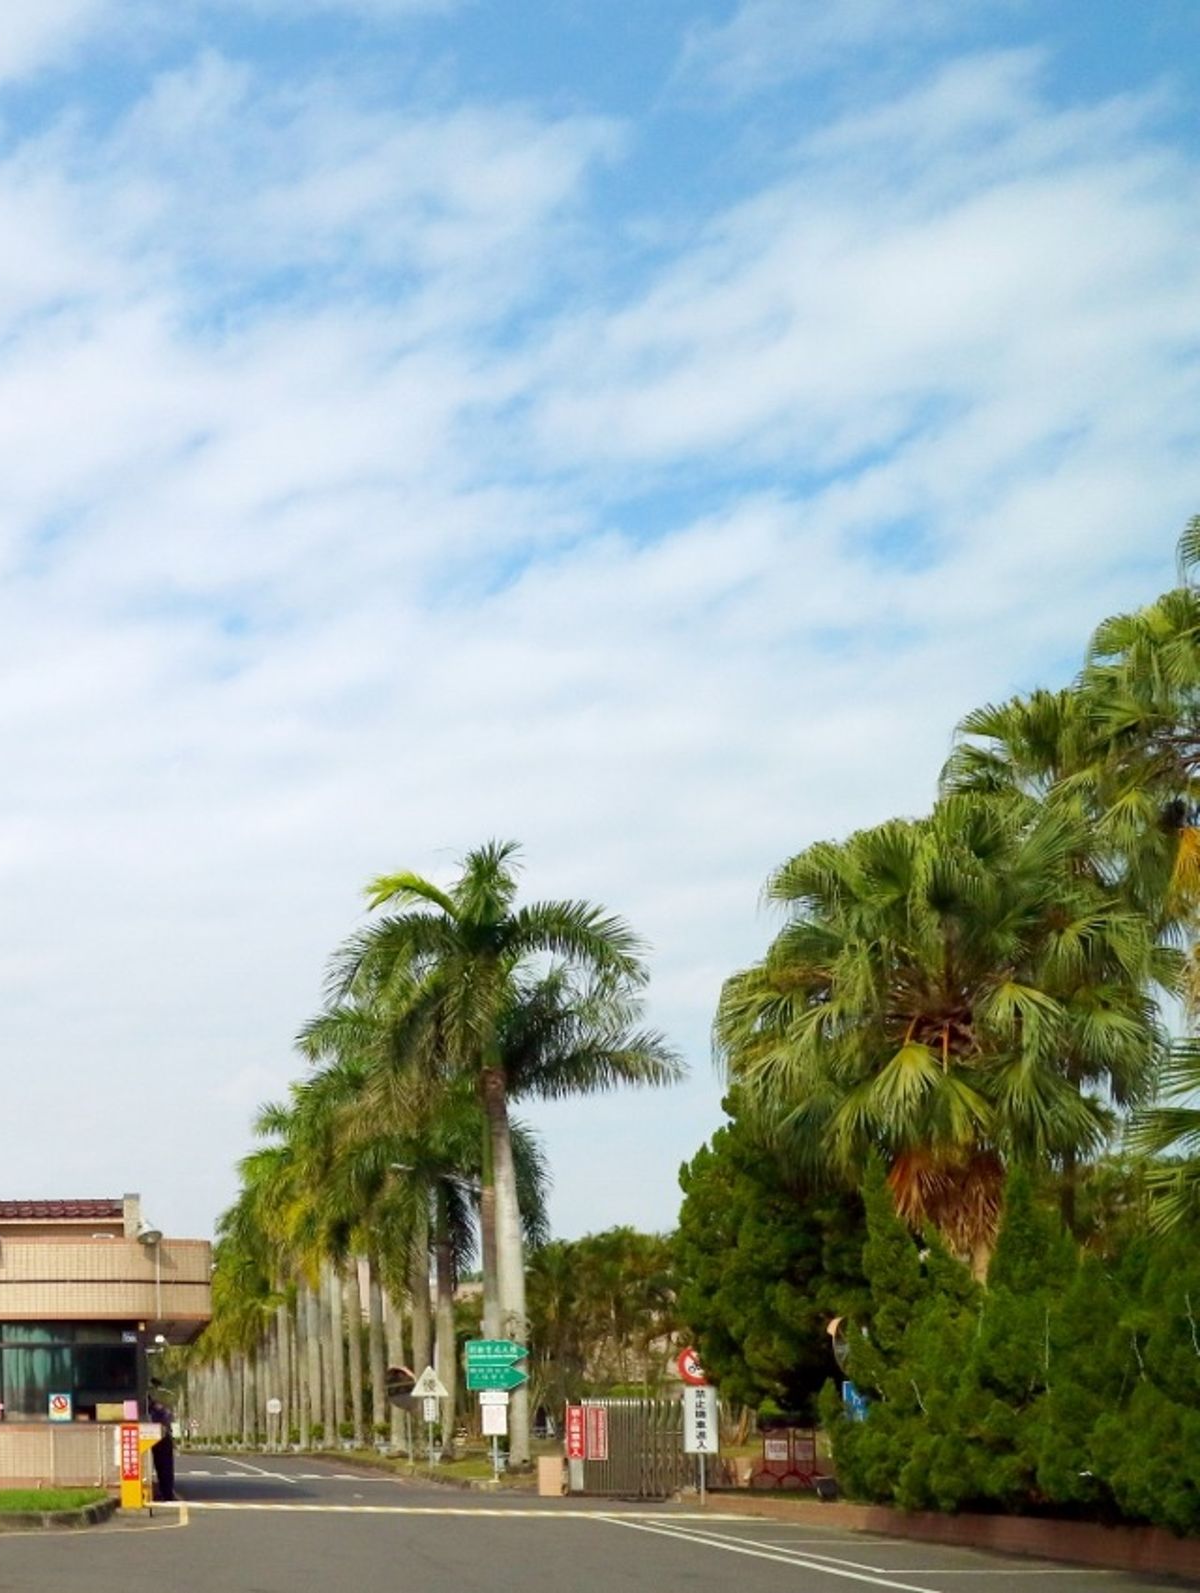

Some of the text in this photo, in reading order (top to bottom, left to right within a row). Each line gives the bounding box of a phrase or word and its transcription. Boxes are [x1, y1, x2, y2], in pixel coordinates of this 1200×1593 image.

[695, 1389, 707, 1449] 禁止機車進入
